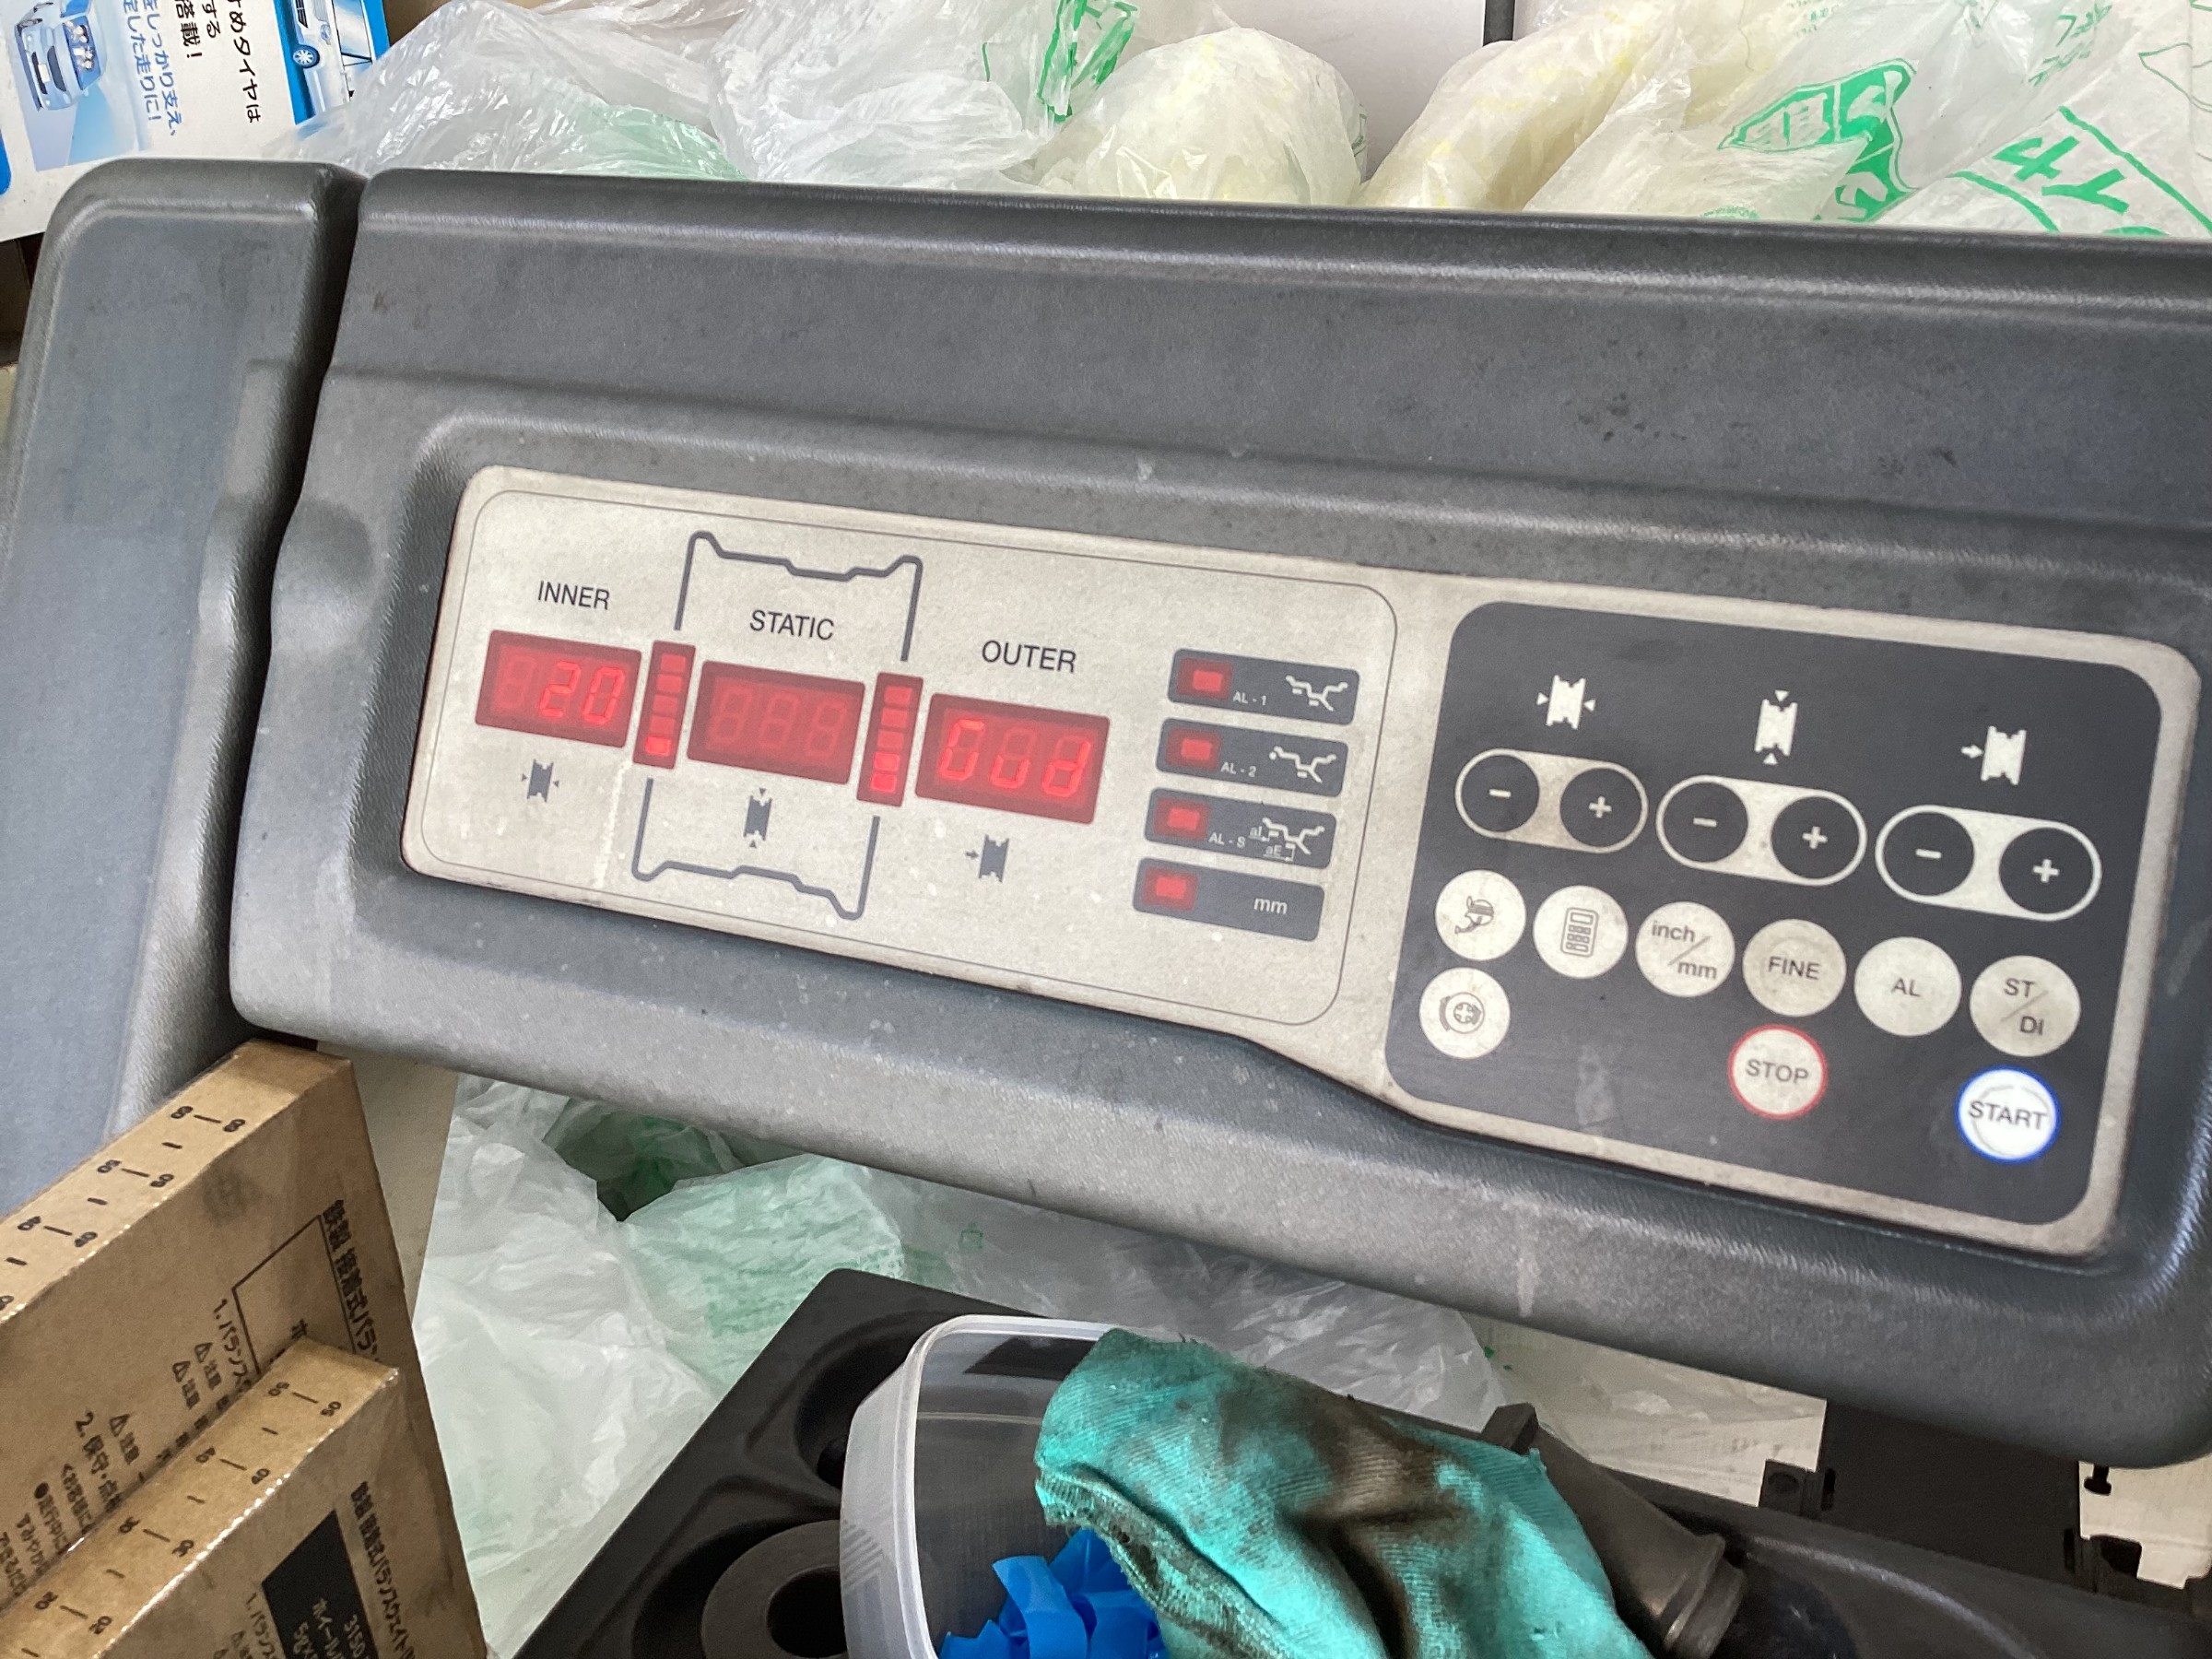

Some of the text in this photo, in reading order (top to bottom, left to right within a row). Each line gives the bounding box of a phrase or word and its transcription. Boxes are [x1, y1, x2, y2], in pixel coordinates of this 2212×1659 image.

[537, 581, 610, 610] INNER
[749, 610, 835, 641] STATIC
[981, 640, 1077, 673] OUTER
[538, 660, 627, 725] 20
[1253, 896, 1288, 915] mm
[1677, 959, 1718, 981] mm
[1767, 957, 1821, 981] FINE
[1891, 977, 1922, 997] AL
[2003, 976, 2036, 998] ST
[2018, 1013, 2045, 1036] DI
[1745, 1058, 1809, 1087] STOP
[1968, 1100, 2048, 1133] START
